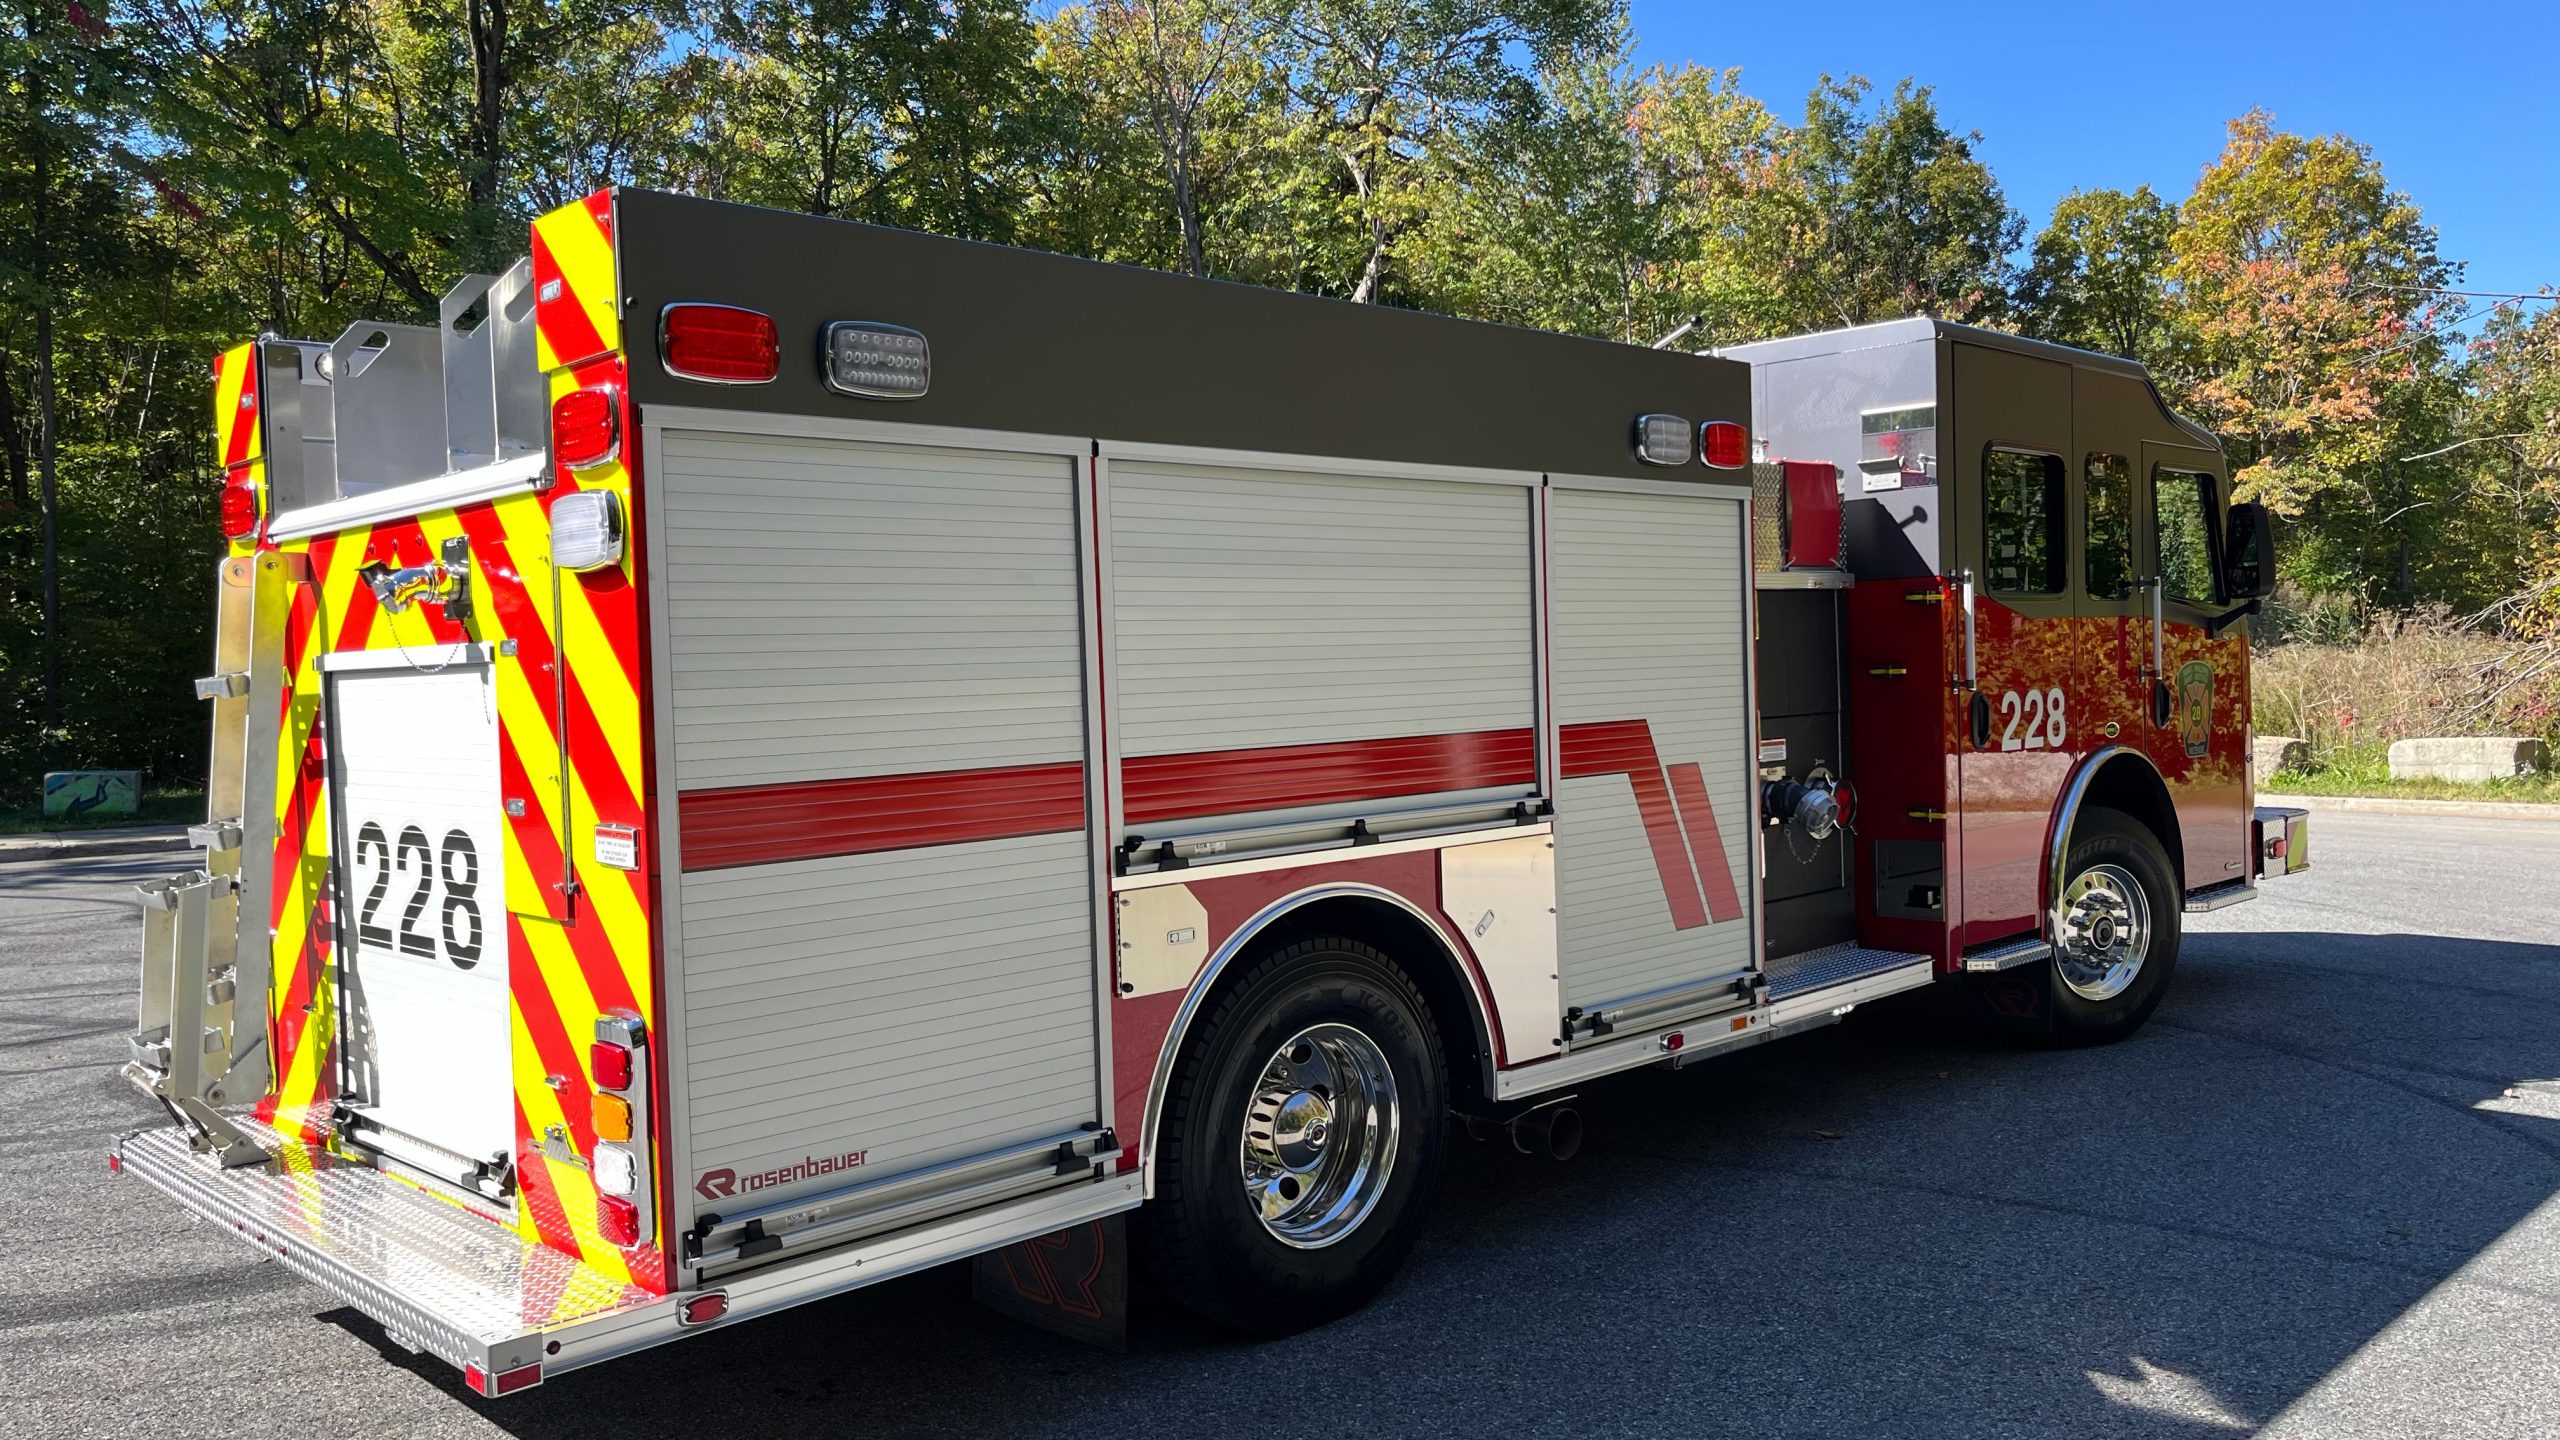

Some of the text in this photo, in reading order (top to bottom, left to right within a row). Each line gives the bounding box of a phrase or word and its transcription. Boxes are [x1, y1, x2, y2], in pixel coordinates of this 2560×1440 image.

[2001, 687, 2066, 752] 228
[2192, 705, 2201, 721] 28
[357, 821, 482, 970] 228
[741, 1149, 869, 1193] rosenbauer
